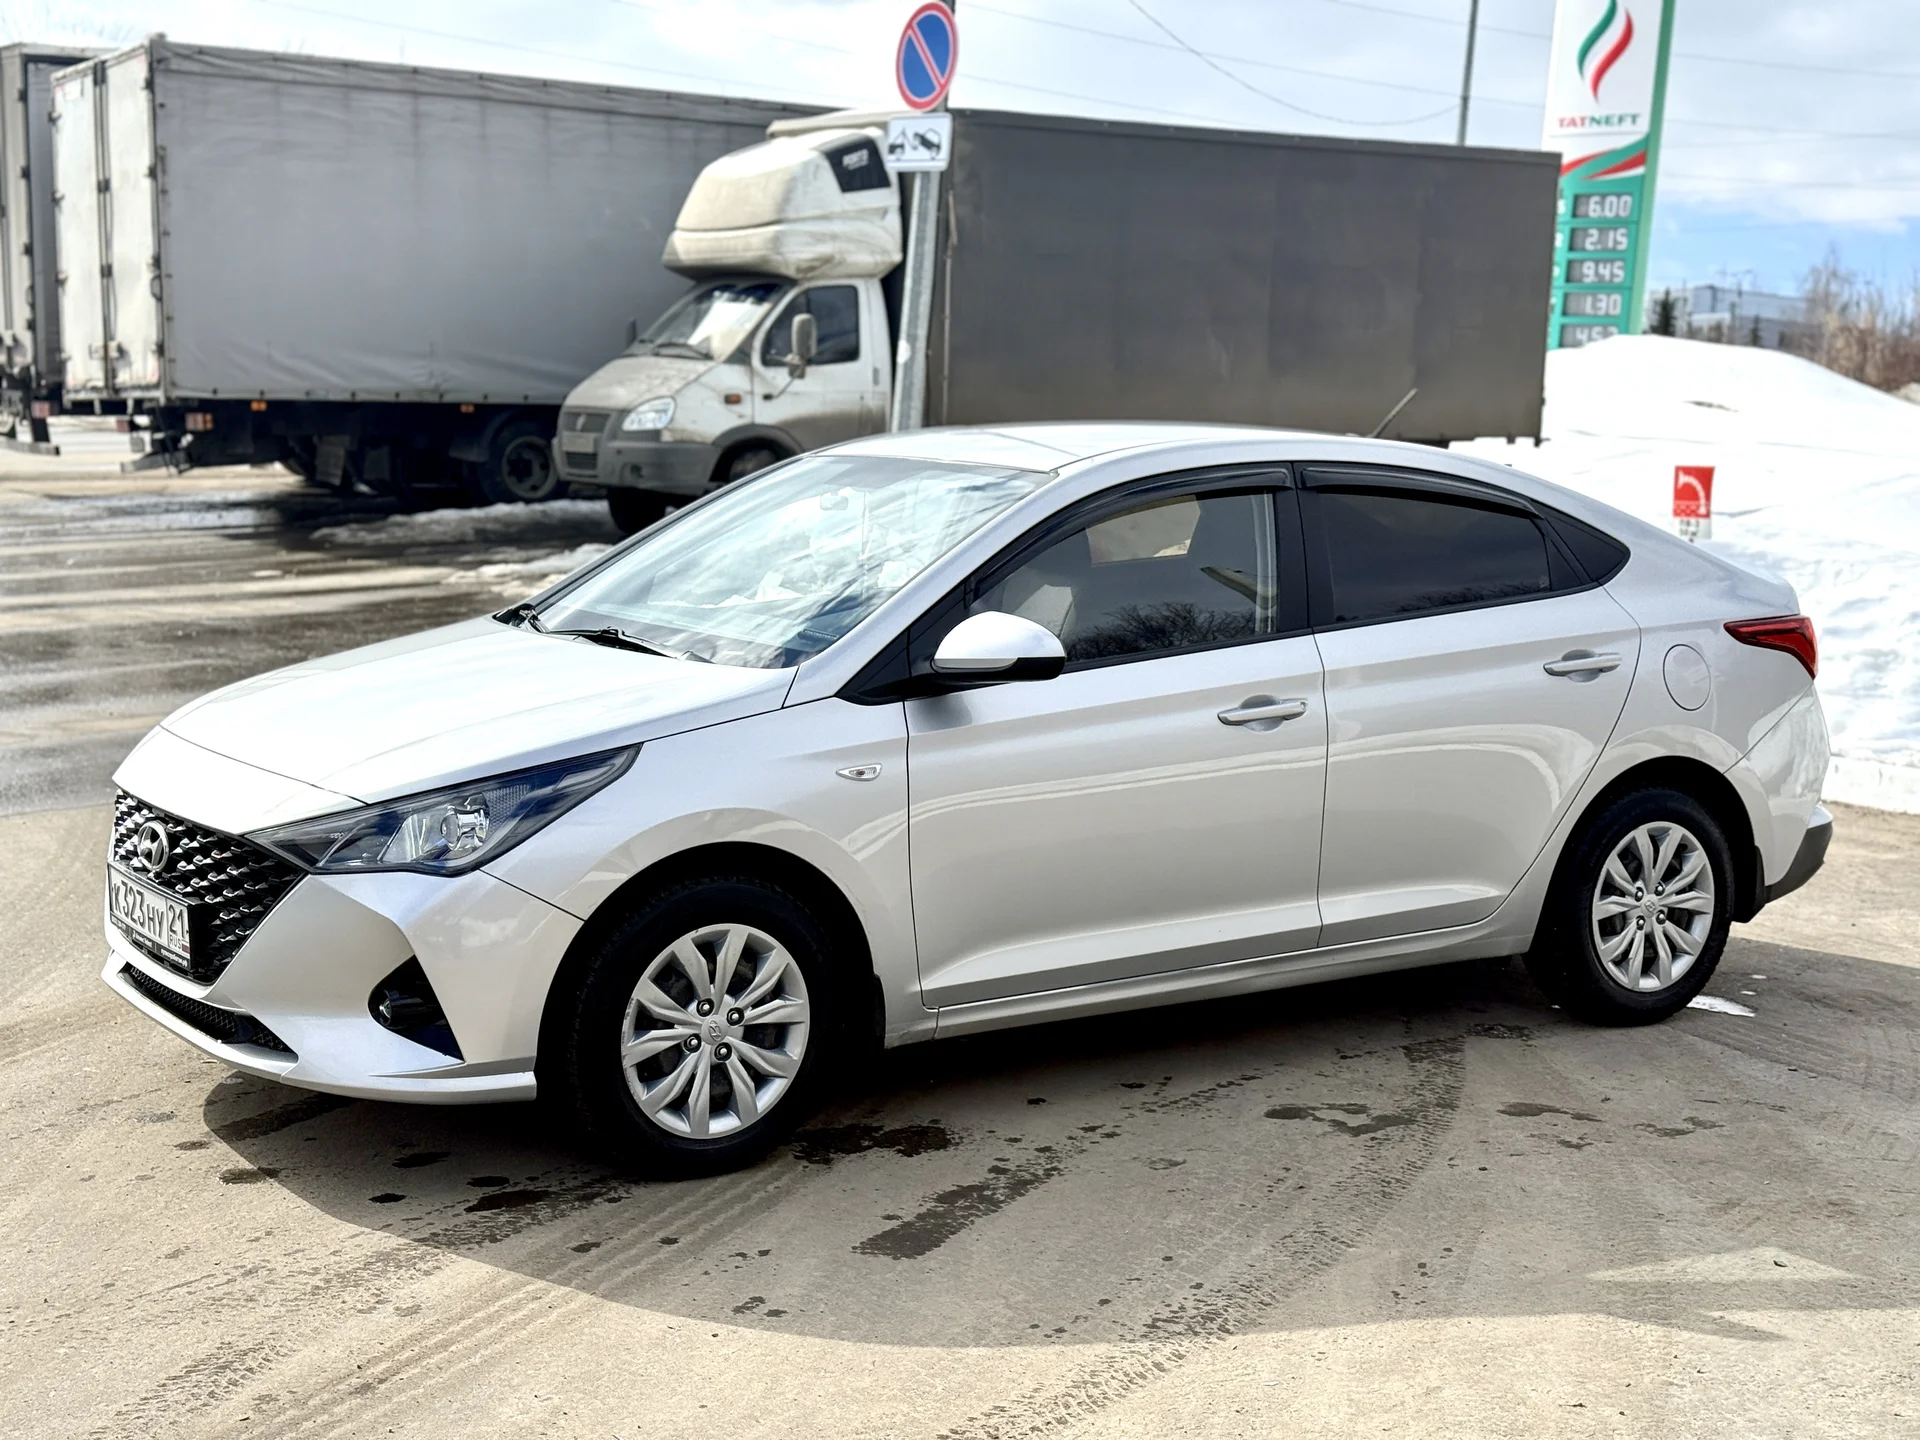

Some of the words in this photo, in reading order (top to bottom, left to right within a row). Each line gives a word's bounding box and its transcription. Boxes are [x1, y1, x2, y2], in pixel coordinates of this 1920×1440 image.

[1558, 112, 1641, 128] TATNEFT
[168, 903, 186, 939] 21
[169, 934, 182, 950] RUS
